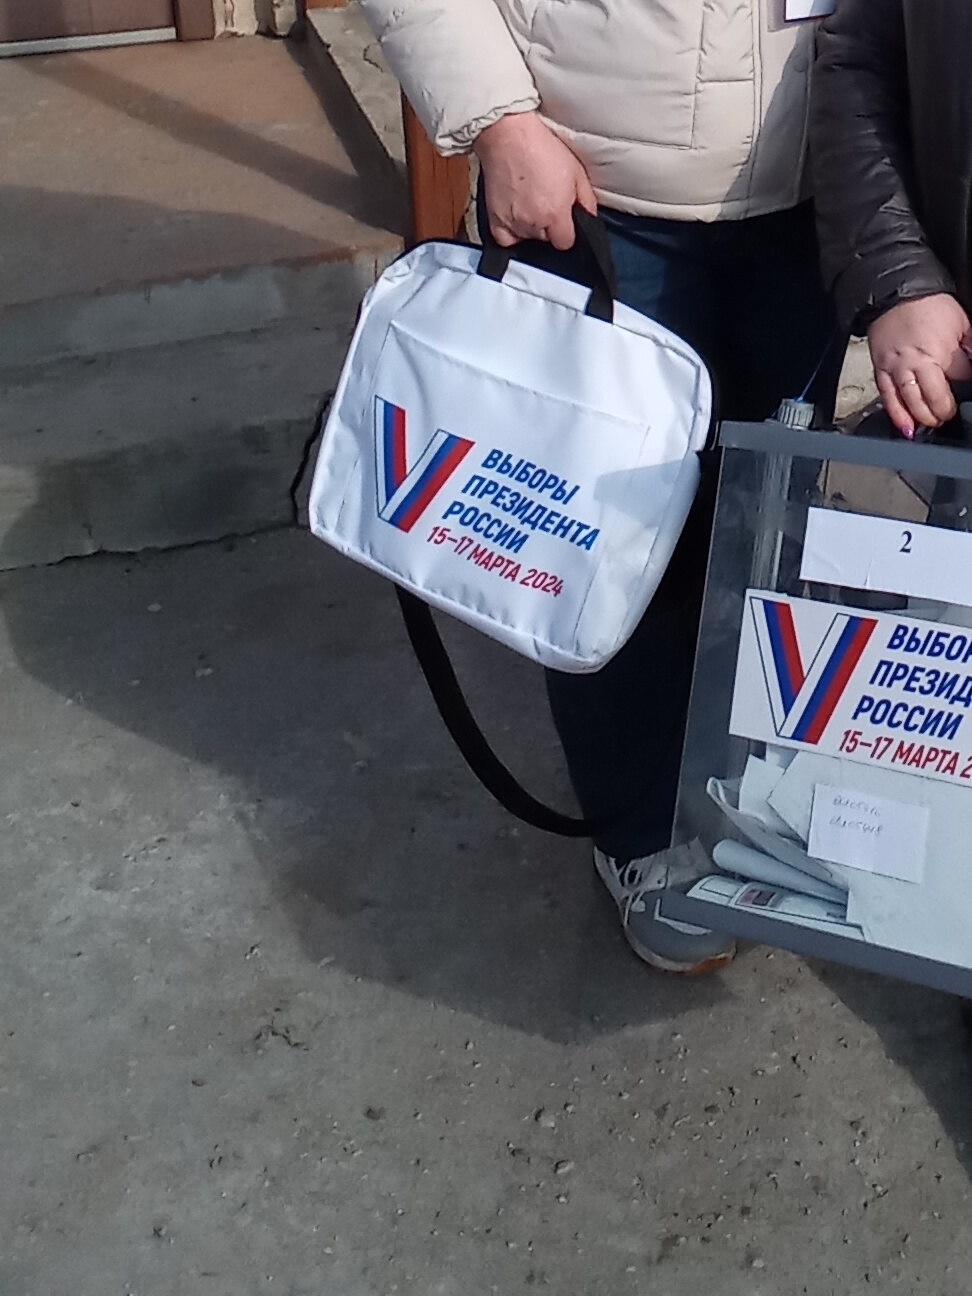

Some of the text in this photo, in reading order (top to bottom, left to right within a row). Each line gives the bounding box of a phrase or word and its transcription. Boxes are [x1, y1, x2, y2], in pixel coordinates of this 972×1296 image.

[481, 448, 581, 506] ВЫБОРЫ
[442, 500, 530, 555] РОССИИ
[461, 474, 602, 551] ПРЕЗИДЕНТА
[899, 530, 913, 553] 2
[469, 546, 520, 581] МАРТА
[520, 569, 564, 598] 2024
[851, 696, 965, 741] РОССИИ
[892, 740, 960, 777] МАРТА
